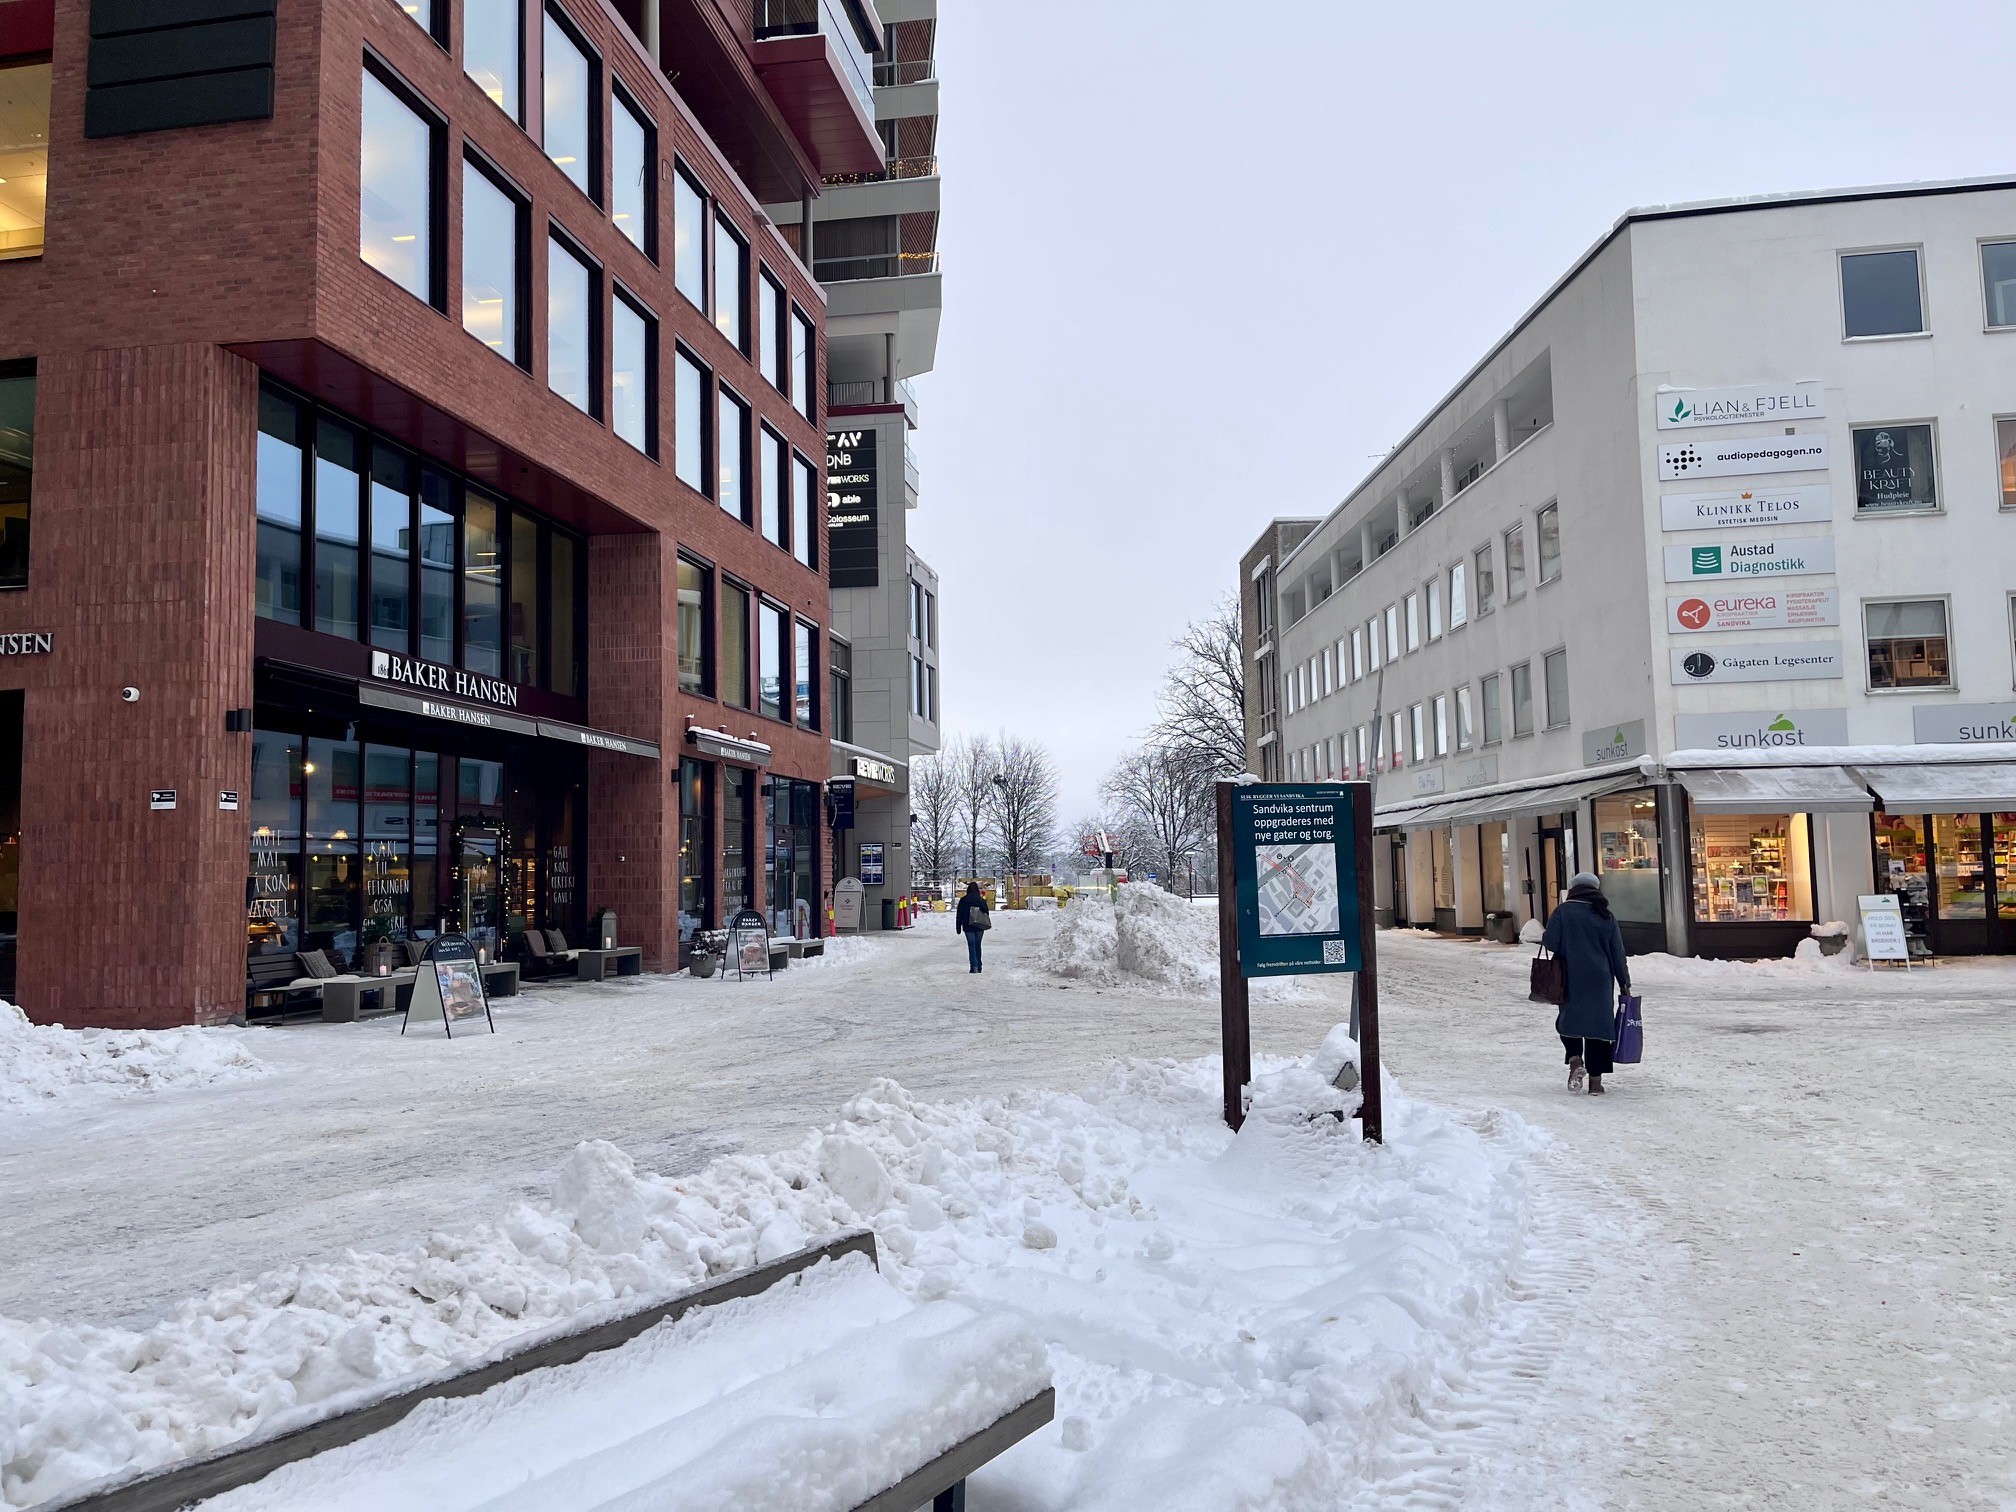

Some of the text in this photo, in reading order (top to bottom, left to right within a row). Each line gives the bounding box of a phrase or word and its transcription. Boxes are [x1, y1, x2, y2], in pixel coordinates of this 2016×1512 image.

[1693, 394, 1816, 416] LIAN & FJELL
[1693, 411, 1765, 422] PSYKOLOGTJENESTER
[826, 450, 852, 469] DNB
[1717, 447, 1823, 461] audiopedagogen.no
[1863, 466, 1915, 479] BEAUTY
[1869, 478, 1911, 490] KRAFT
[1877, 491, 1909, 499] Hudpleie
[1696, 500, 1800, 517] KLINIKK TELOS
[1730, 543, 1774, 557] Austad
[1730, 558, 1805, 575] Diagnostikk
[1714, 596, 1776, 612] eureka
[1786, 597, 1829, 605] FYSIOTERAPEUT
[1717, 620, 1751, 628] SANDVIKA
[1722, 655, 1834, 670] Gågaten Legesenter
[391, 655, 450, 692] BAKER
[455, 671, 518, 707] HANSEN
[430, 703, 491, 726] BAKER HANSEN
[1959, 720, 2016, 740] sunk
[585, 733, 627, 751] BAKER HANSEN
[1717, 728, 1805, 748] sunkost
[1596, 741, 1628, 761] sunkost
[1253, 803, 1334, 815] Sandvika sentrum
[1254, 815, 1334, 829] oppgraderes med
[1255, 829, 1335, 842] nye gater og torg.
